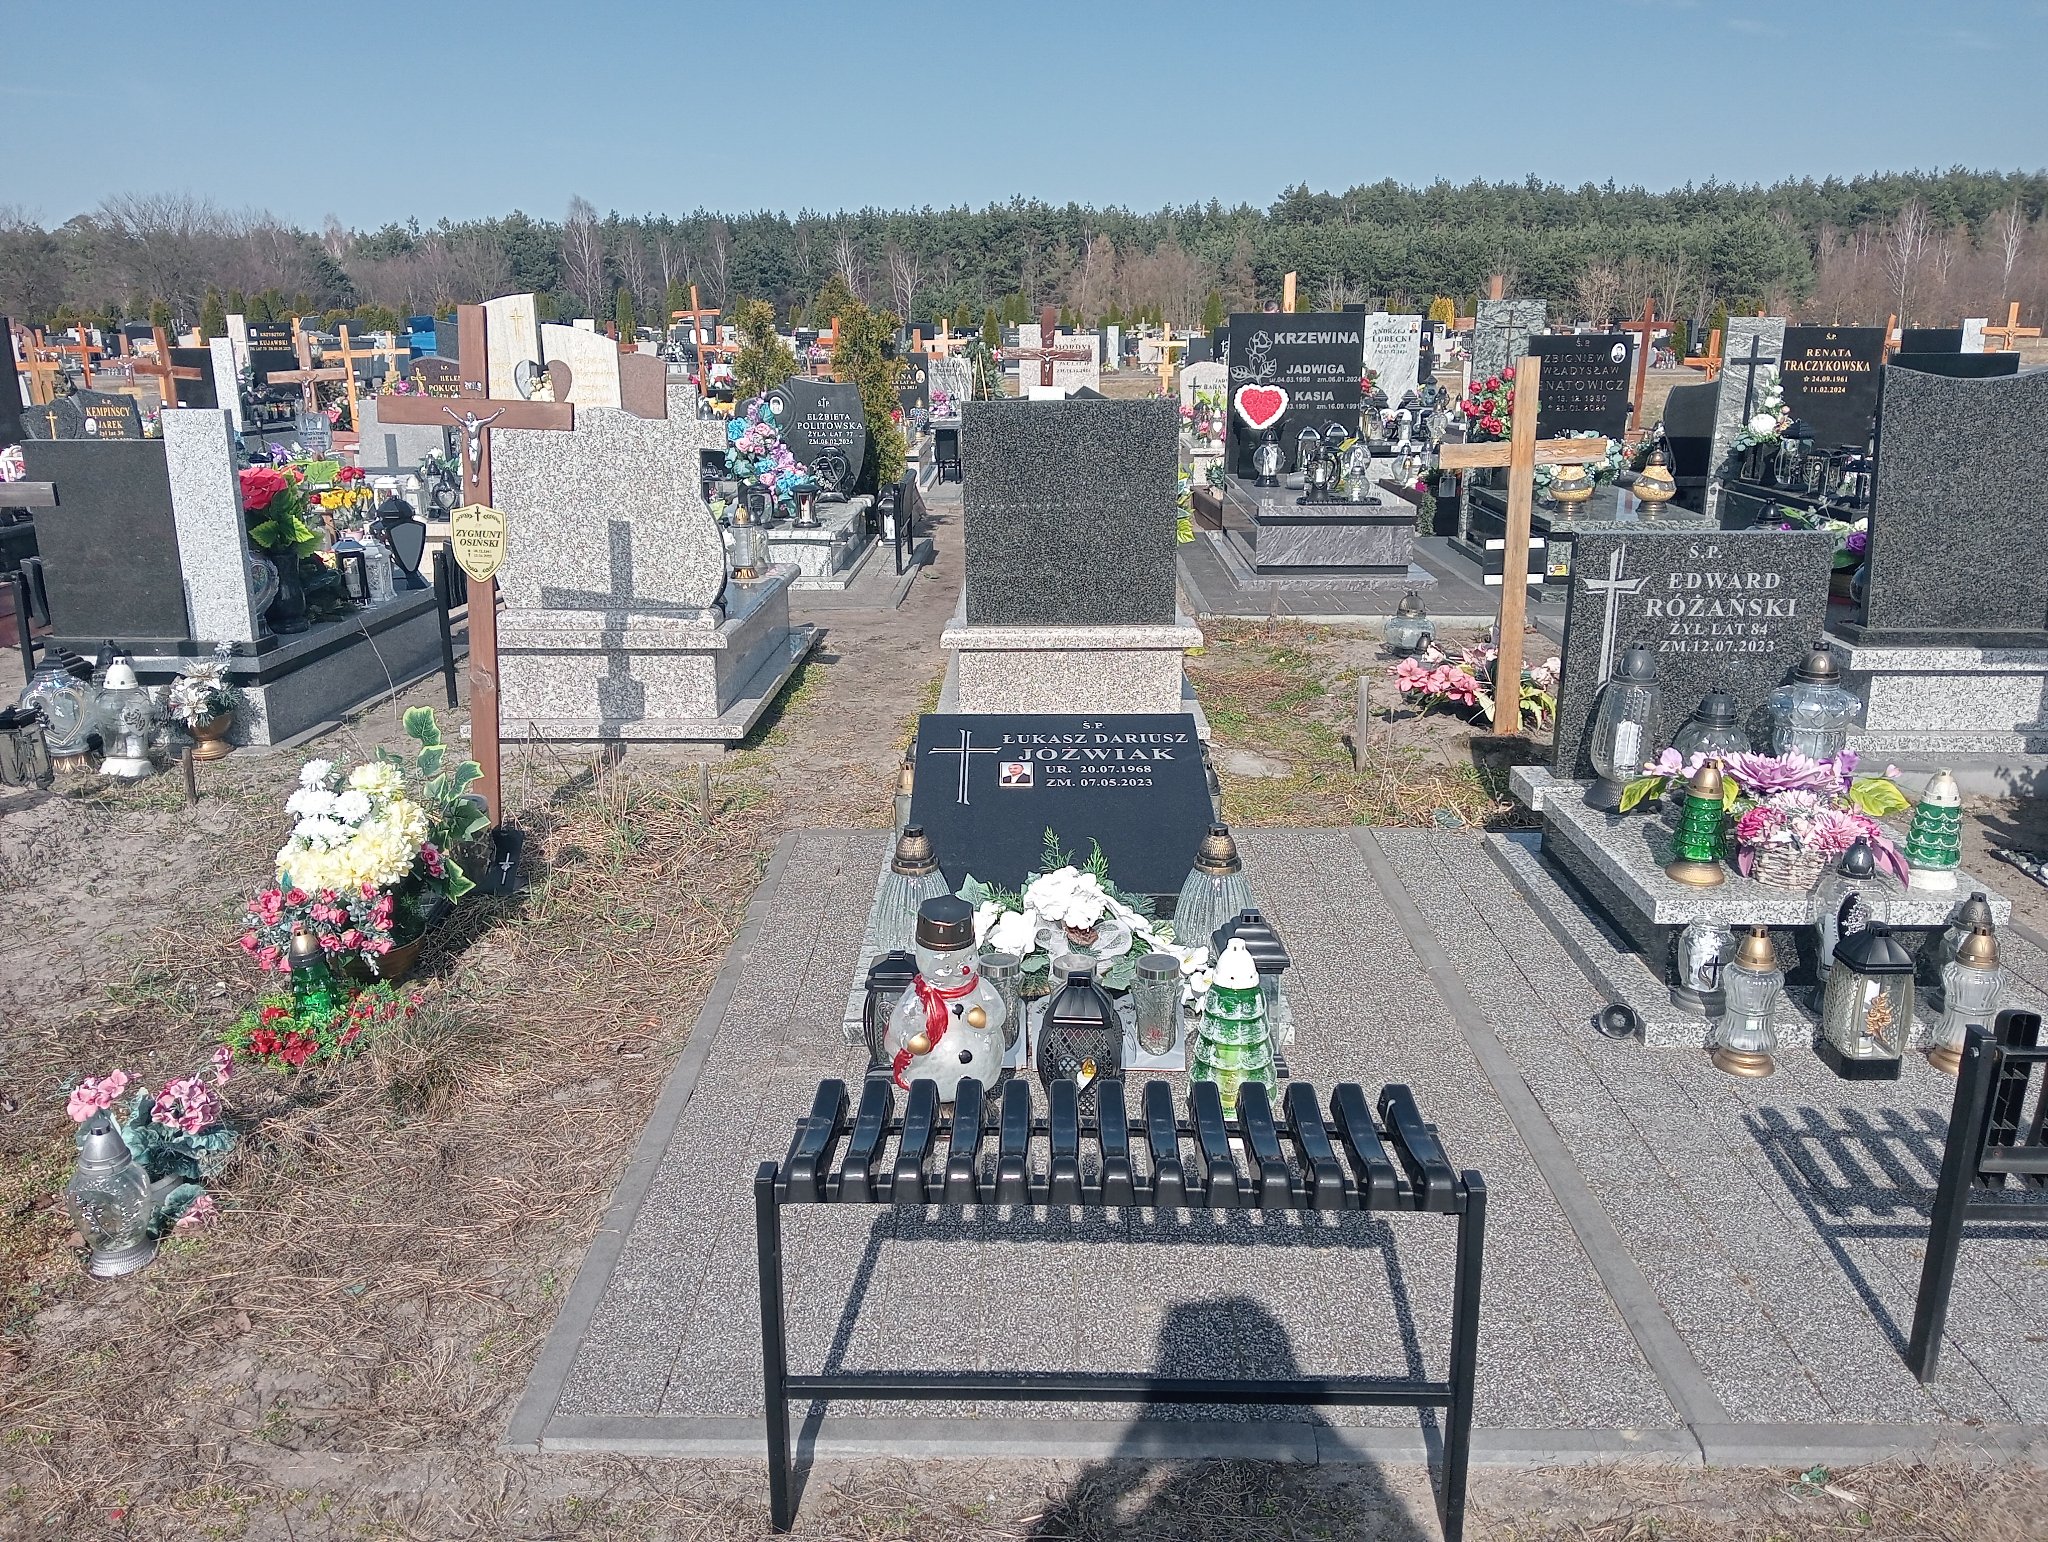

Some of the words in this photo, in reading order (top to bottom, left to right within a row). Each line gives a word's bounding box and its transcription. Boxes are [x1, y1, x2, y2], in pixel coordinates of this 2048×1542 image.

[1274, 332, 1360, 344] KRZEWINA
[1806, 348, 1852, 357] RENATA
[1544, 354, 1605, 363] ZBIGNIEW
[1286, 364, 1346, 374] JADWIGA
[1543, 366, 1619, 376] WŁADYSŁAW
[1784, 360, 1871, 372] TRACZYKOWSKA
[1295, 391, 1334, 401] KASIA
[807, 412, 850, 420] ELŻBIETA
[98, 420, 123, 428] JAREK
[456, 530, 502, 538] ZYGMUNT
[1689, 542, 1723, 559] Ś.P.
[1668, 572, 1781, 589] EDWARD
[1642, 593, 1798, 617] RÓŻAŃSKI
[1669, 620, 1705, 635] ŻYŁ
[1711, 623, 1746, 635] LAT
[1750, 622, 1768, 635] 84
[1658, 640, 1775, 652] ZM.12.07.2023
[1082, 720, 1106, 730] Ś.P.
[1002, 733, 1088, 744] ŁUKASZ
[1094, 733, 1189, 744] DARIUSZ
[1045, 765, 1072, 774] UR.
[1080, 765, 1152, 774] 20.07.1968
[1046, 778, 1076, 787] ZM.
[1080, 778, 1153, 787] 07.05.2023
